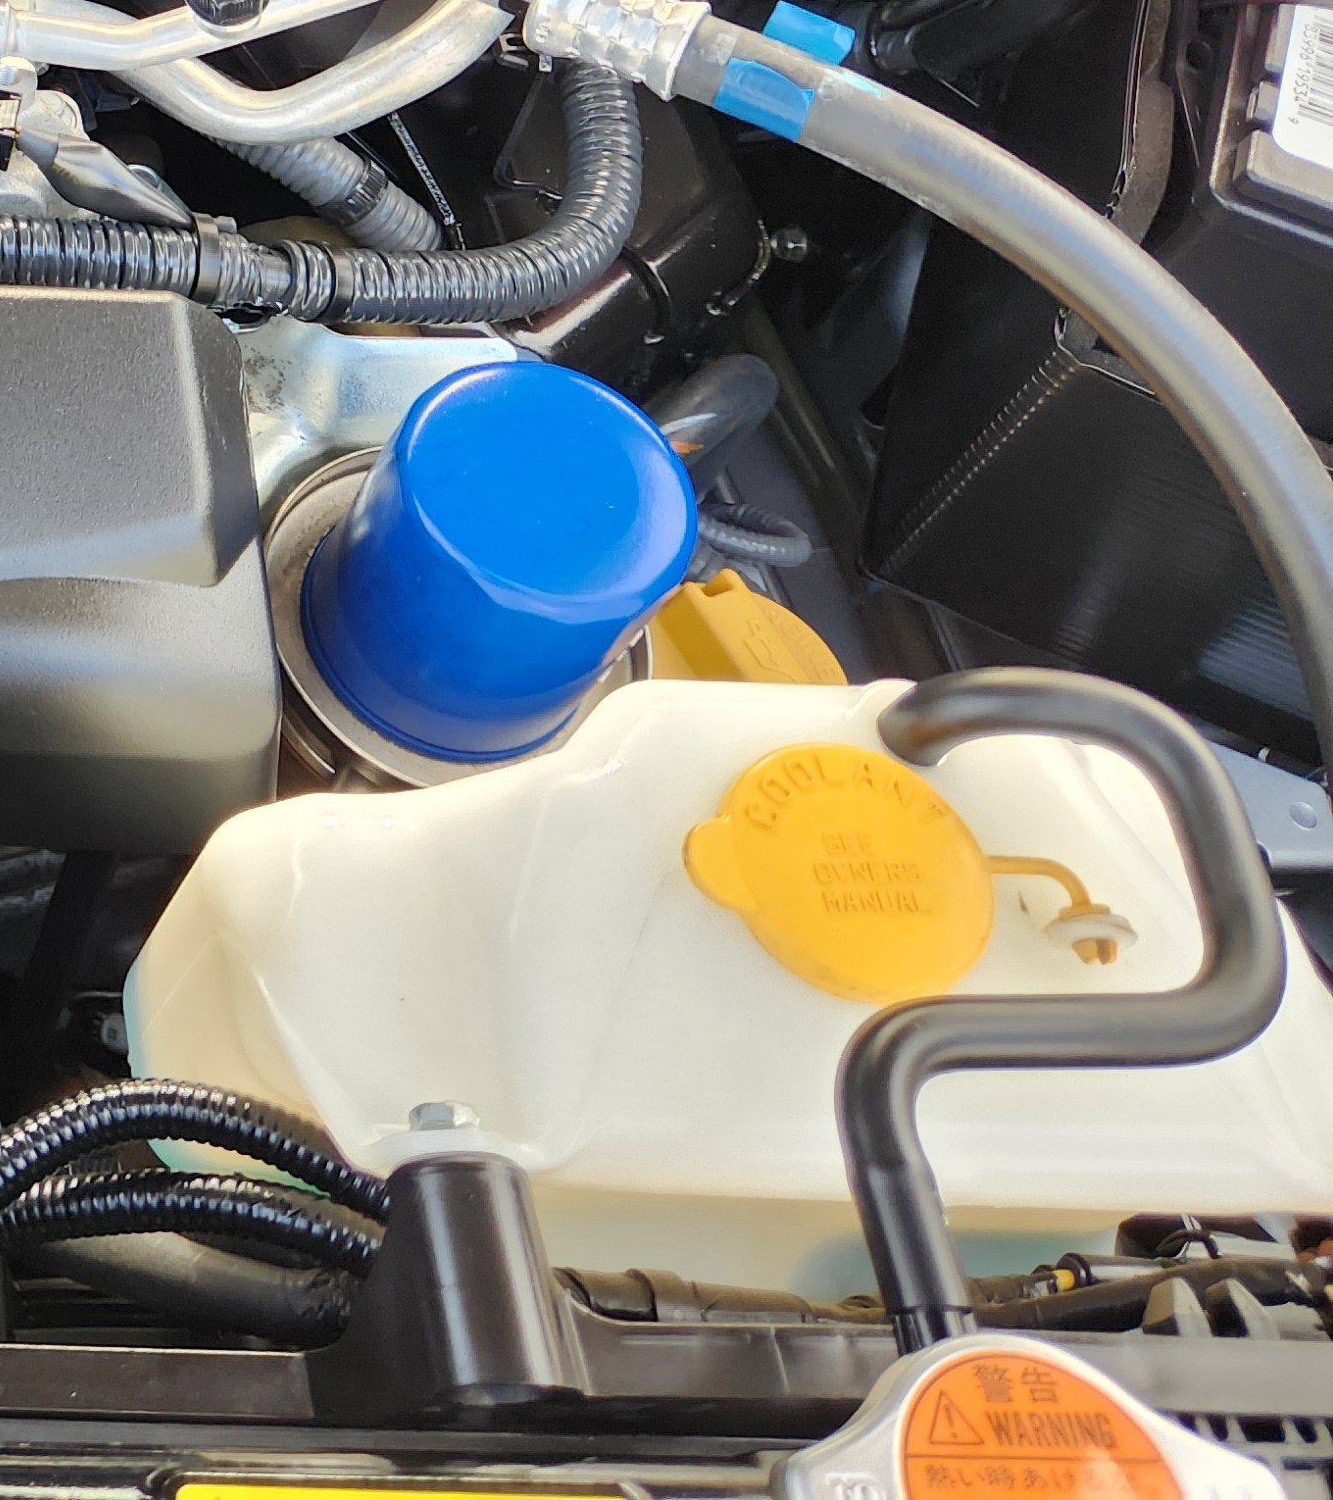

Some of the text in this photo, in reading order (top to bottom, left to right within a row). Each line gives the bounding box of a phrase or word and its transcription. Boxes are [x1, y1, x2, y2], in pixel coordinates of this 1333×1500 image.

[744, 752, 947, 831] COOLANT
[821, 890, 932, 915] MANUAL
[974, 1363, 1060, 1403] 警告
[985, 1410, 1118, 1450] WARNING
